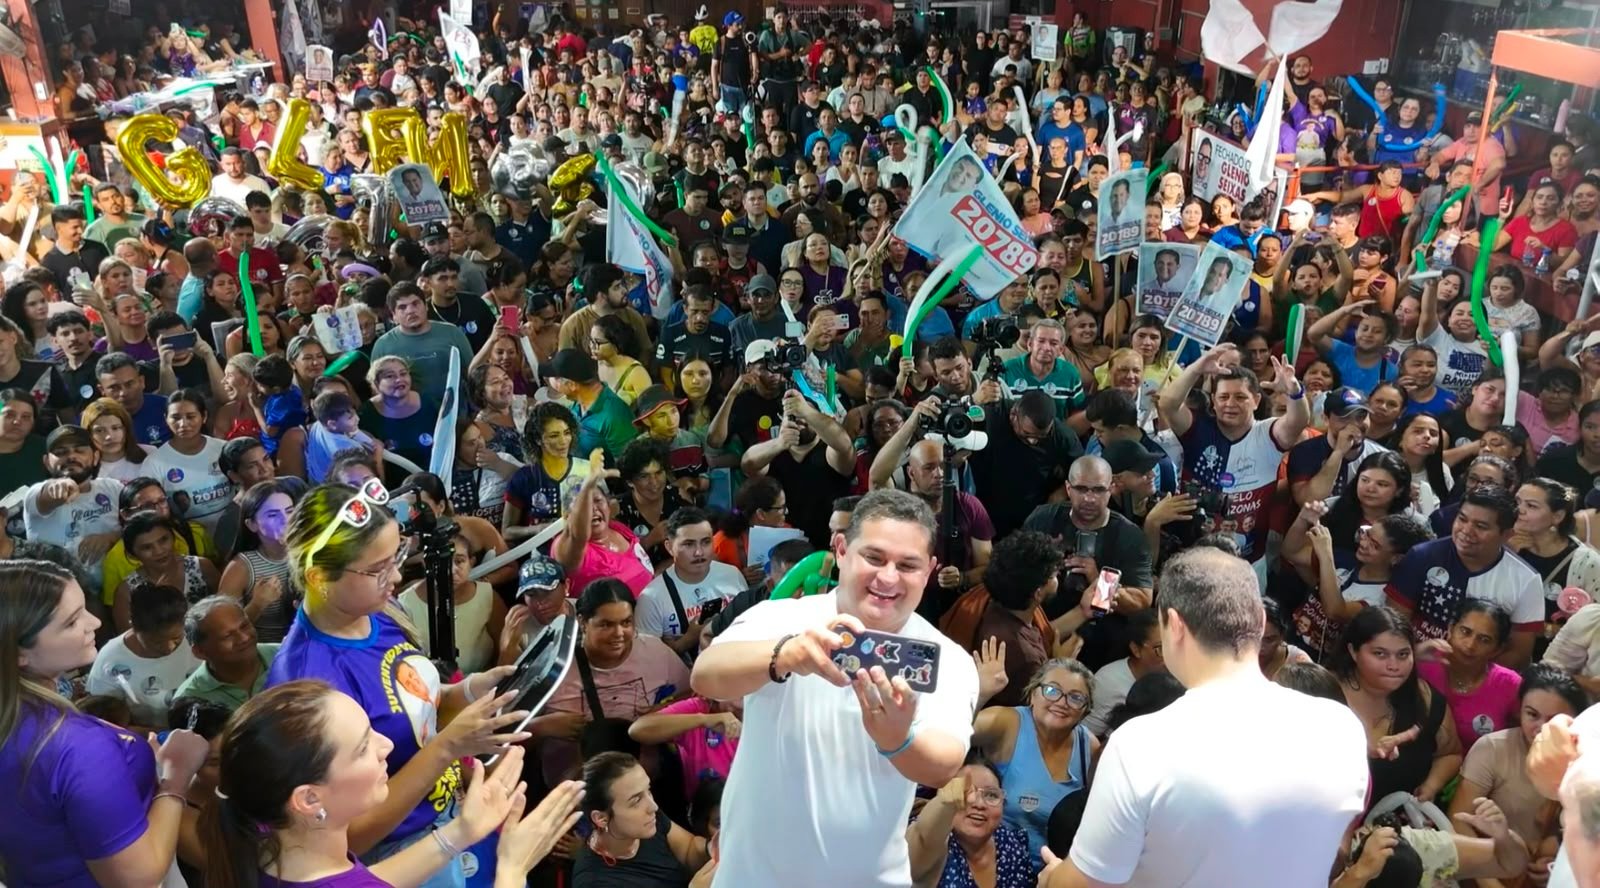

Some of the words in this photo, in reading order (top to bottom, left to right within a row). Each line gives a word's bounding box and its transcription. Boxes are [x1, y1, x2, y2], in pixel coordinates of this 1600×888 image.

[1221, 161, 1250, 187] GLENIO
[1218, 177, 1246, 202] SEIXAS
[973, 189, 1012, 229] GLENIO
[957, 199, 1037, 275] 20789
[1101, 225, 1140, 245] 20789
[1177, 304, 1220, 332] 20789
